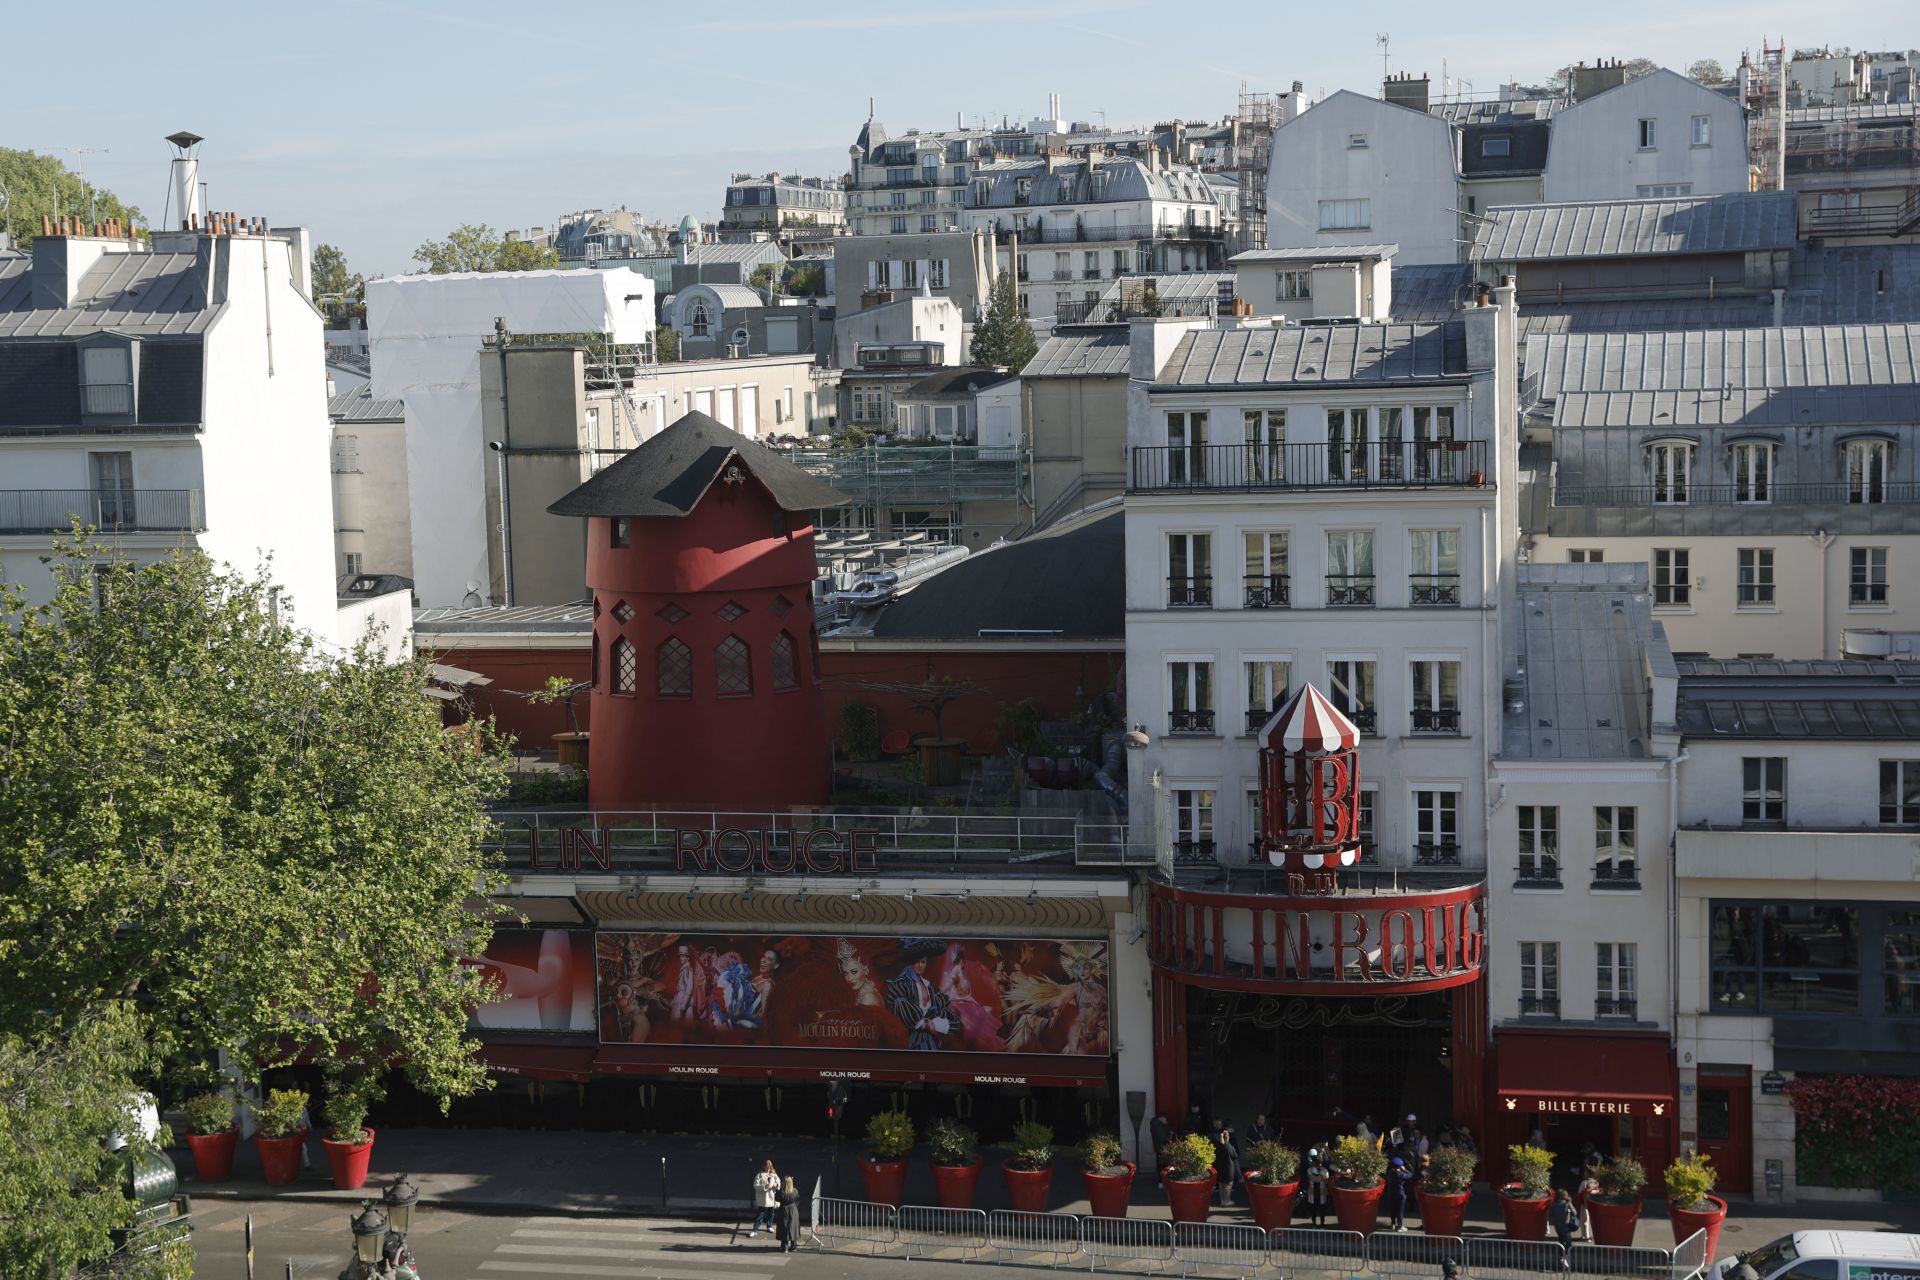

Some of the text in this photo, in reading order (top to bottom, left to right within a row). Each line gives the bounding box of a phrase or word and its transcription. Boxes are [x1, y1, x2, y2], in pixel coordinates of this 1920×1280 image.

[675, 826, 880, 873] ROUGE
[1150, 896, 1486, 982] OULIN ROUG
[799, 1023, 879, 1040] MOULIN ROUGE
[1538, 1100, 1631, 1114] BILLETTERIE
